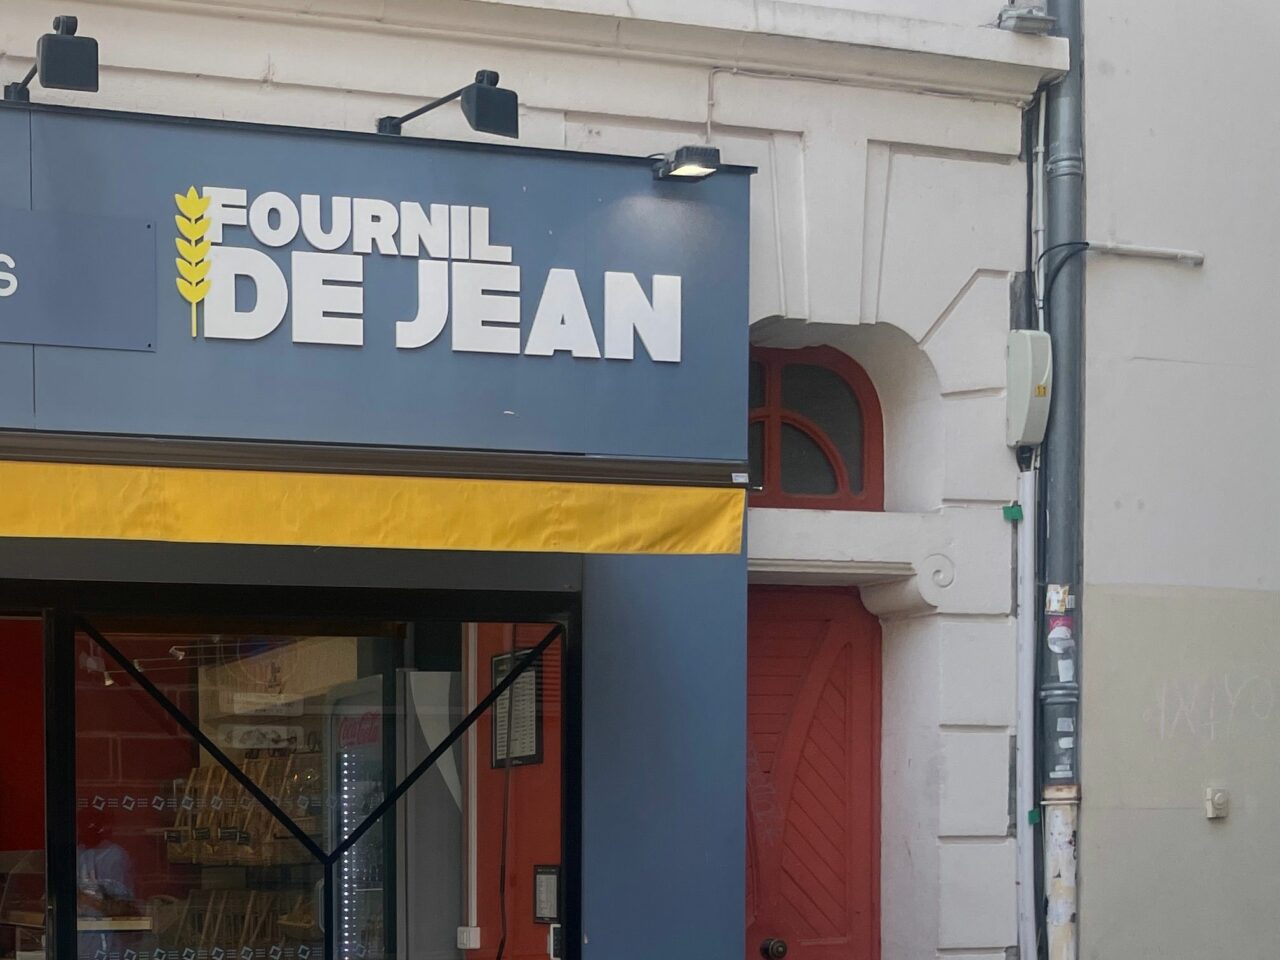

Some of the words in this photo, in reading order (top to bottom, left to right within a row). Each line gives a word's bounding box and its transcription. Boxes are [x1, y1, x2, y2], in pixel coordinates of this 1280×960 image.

[202, 186, 513, 264] FOURNIL
[202, 245, 364, 346] DE
[395, 259, 682, 363] JEAN
